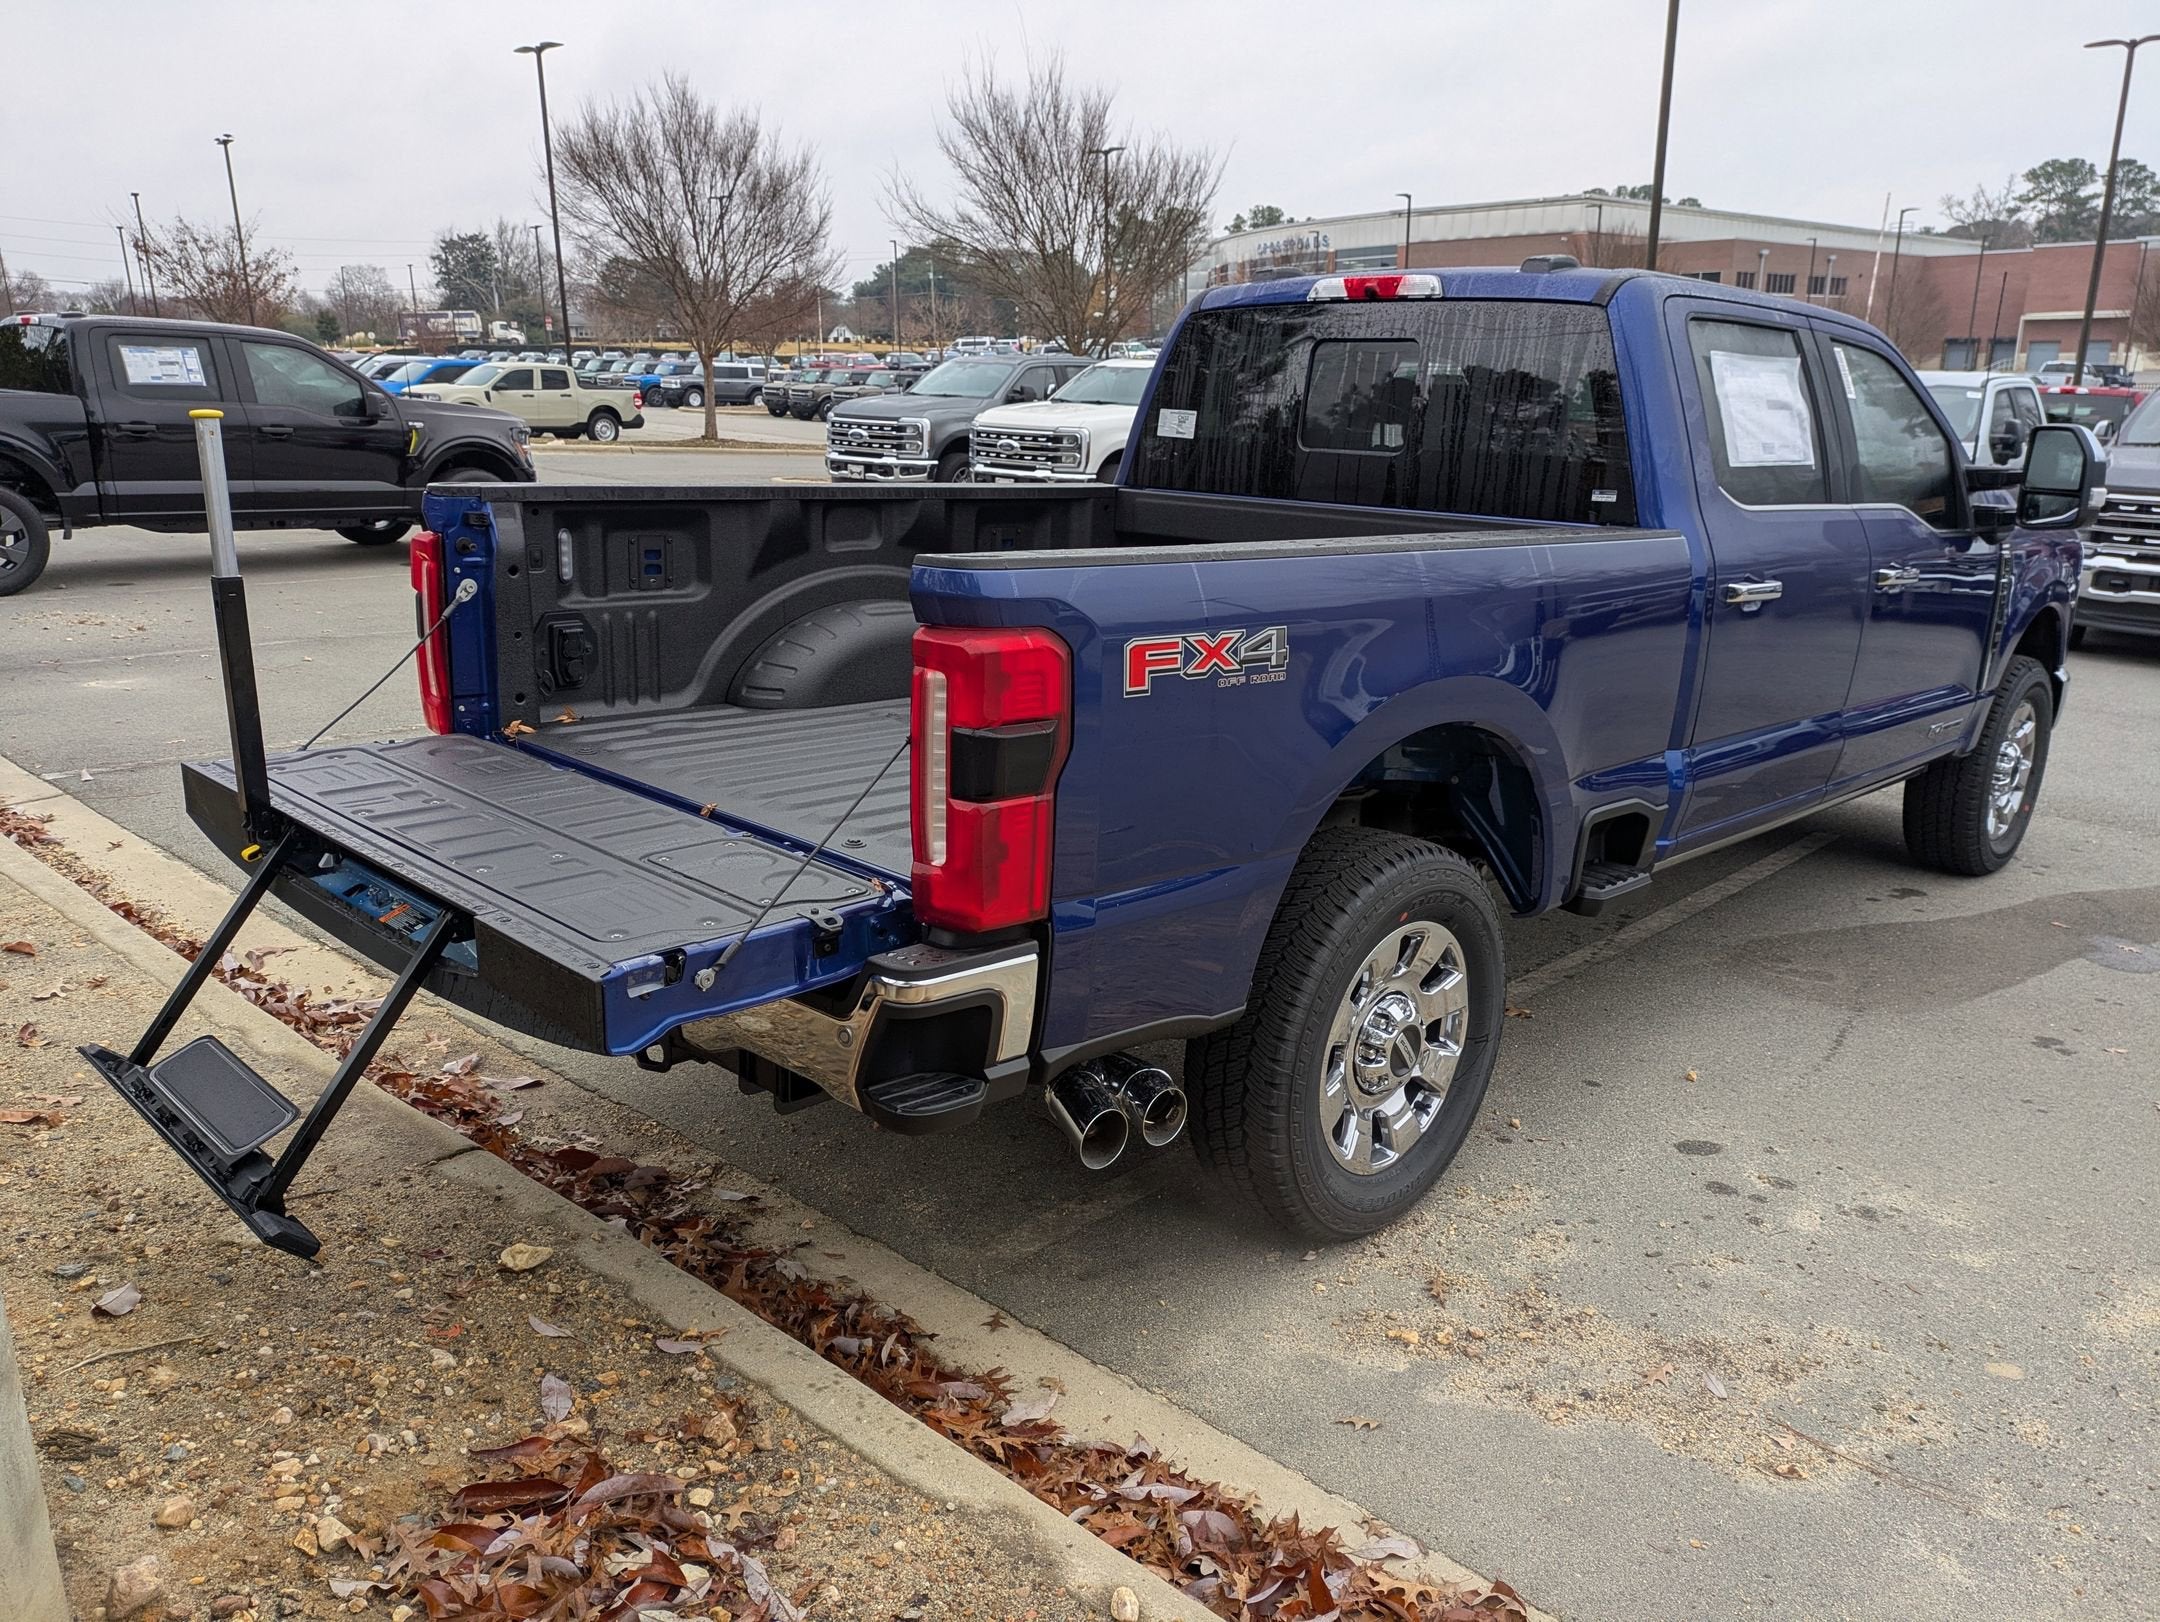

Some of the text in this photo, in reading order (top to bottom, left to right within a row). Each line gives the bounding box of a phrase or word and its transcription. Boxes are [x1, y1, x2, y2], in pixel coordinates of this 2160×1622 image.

[1124, 626, 1289, 698] FX4
[1218, 672, 1287, 688] OFF ROAD
